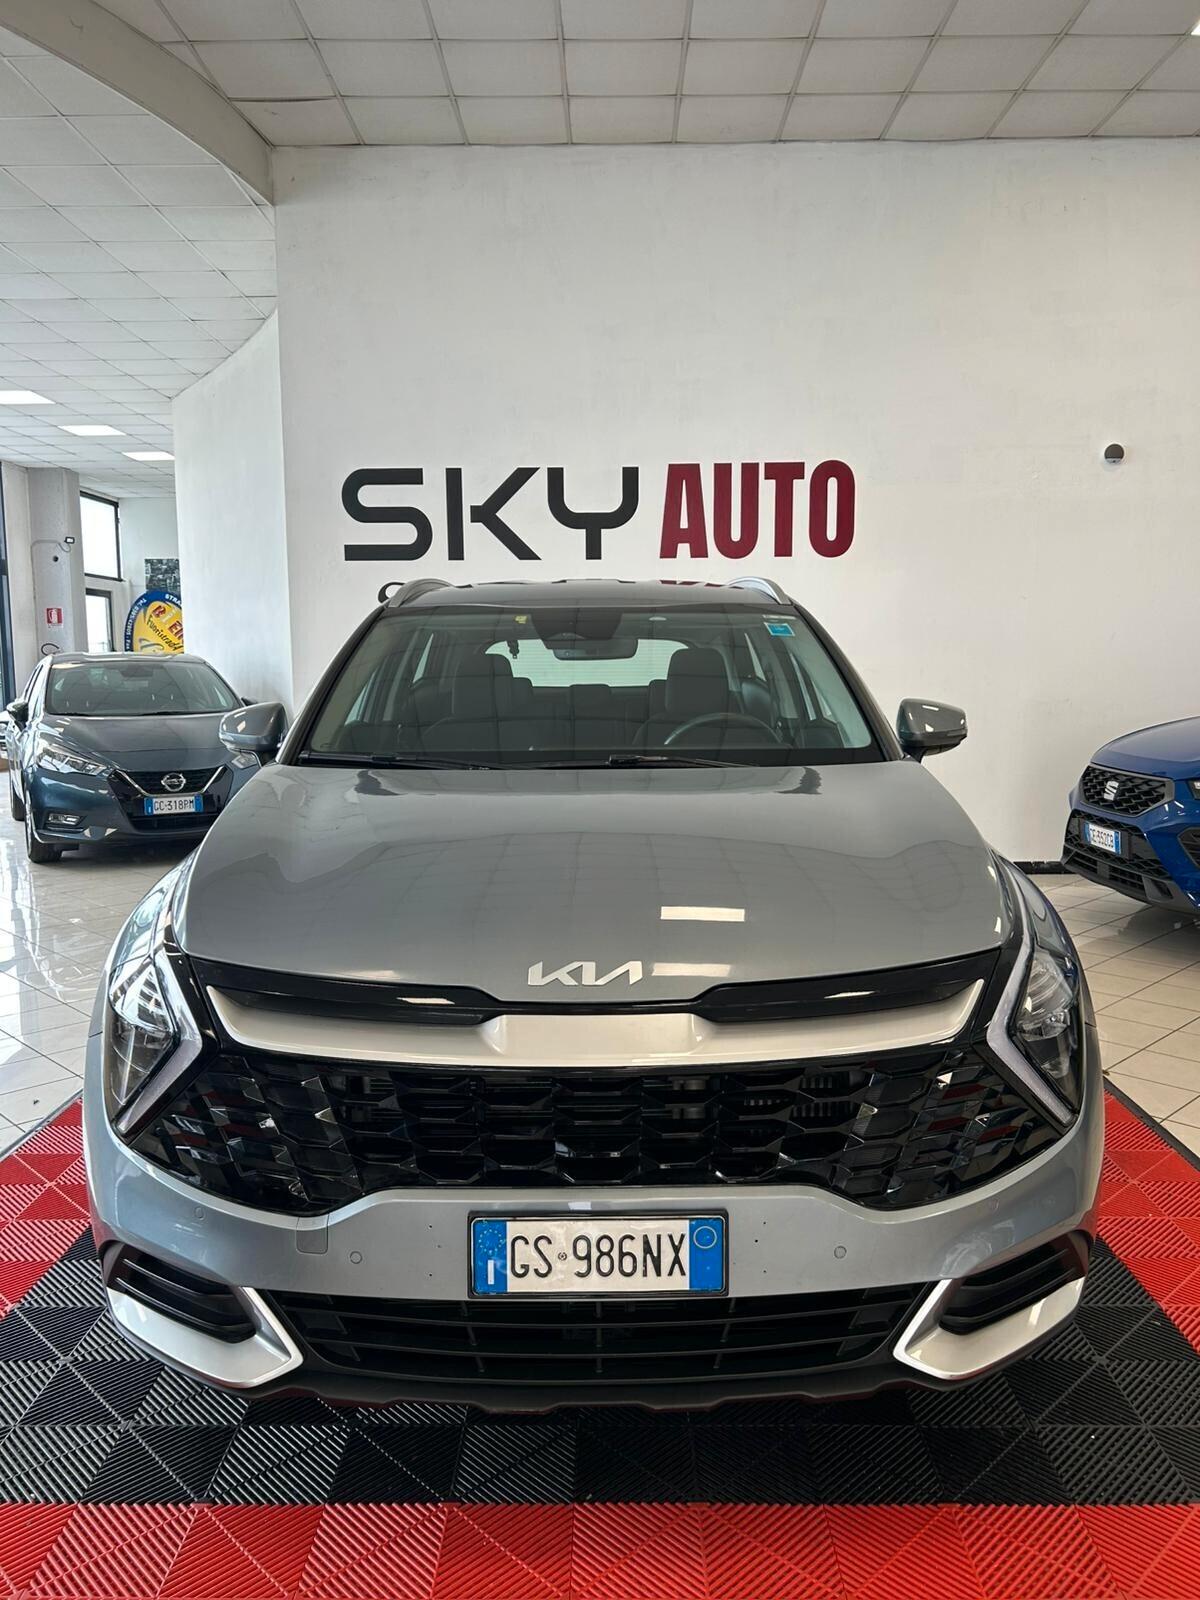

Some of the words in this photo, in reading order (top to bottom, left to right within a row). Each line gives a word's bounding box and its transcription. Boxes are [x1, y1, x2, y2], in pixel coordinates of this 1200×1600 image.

[341, 466, 640, 561] SKY
[659, 459, 857, 560] AUTO
[164, 593, 182, 606] STRA
[510, 1234, 553, 1279] GS
[572, 1233, 687, 1278] 986NX
